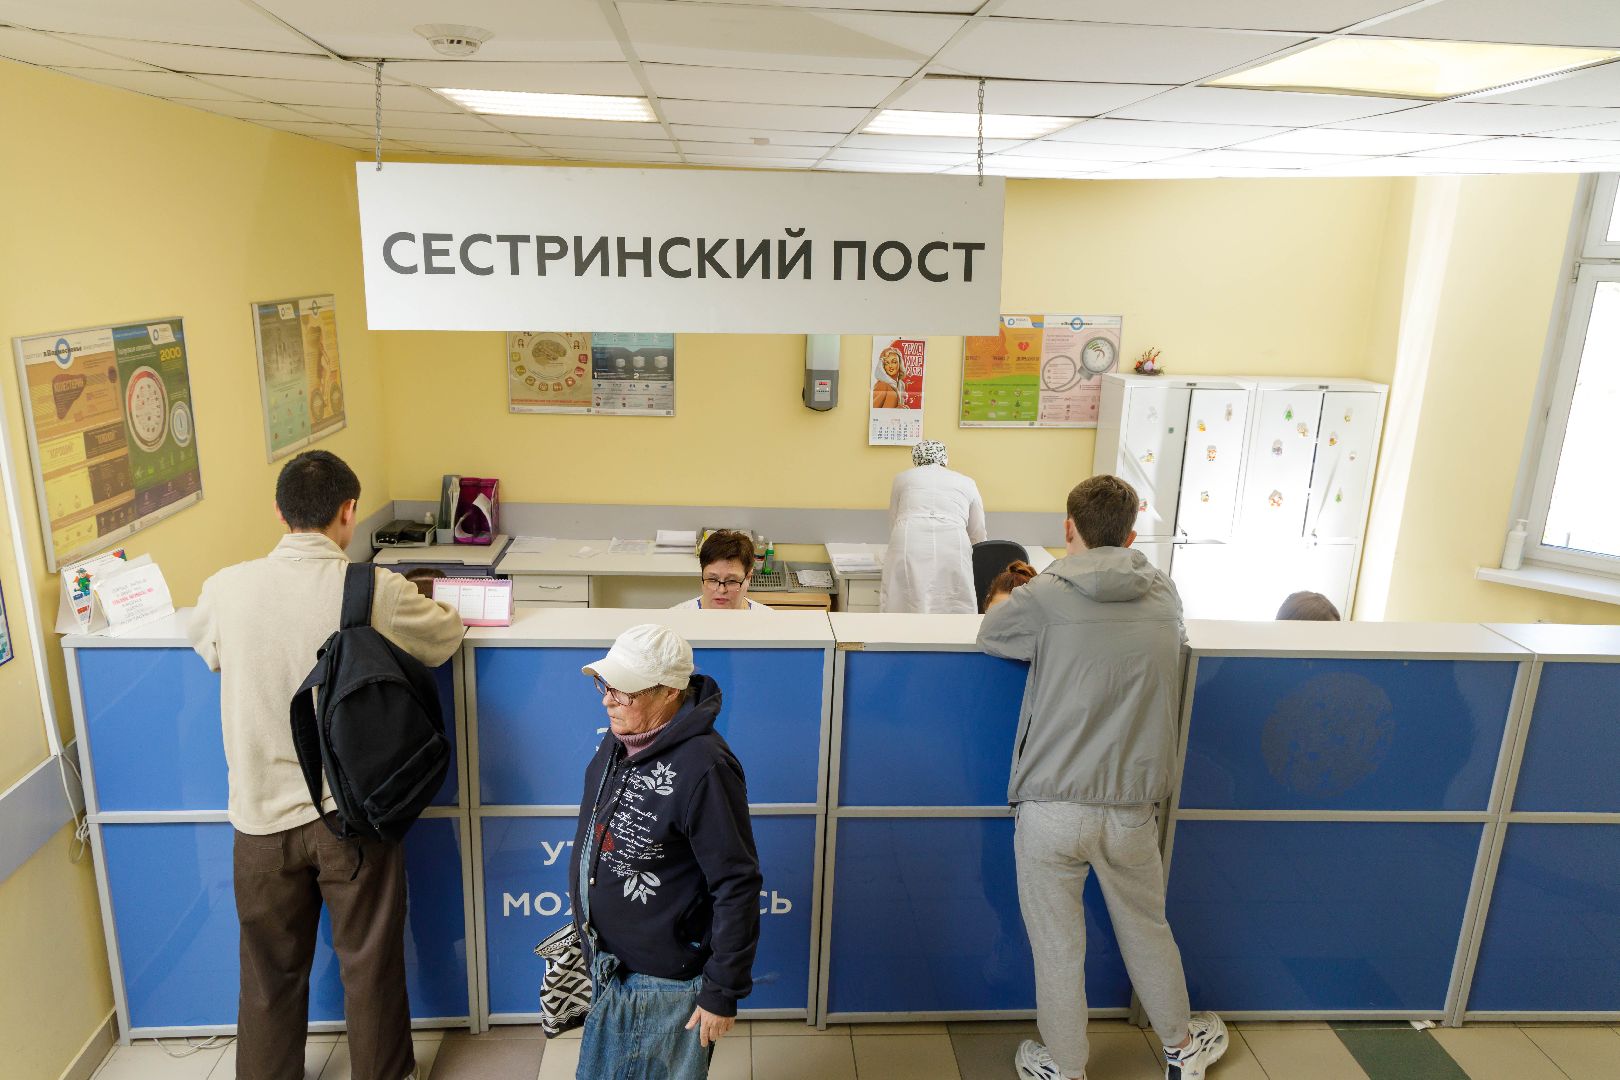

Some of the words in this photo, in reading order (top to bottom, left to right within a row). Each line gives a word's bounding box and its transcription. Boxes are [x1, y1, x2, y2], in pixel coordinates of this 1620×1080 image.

[383, 228, 812, 280] СЕСТРИНСКИЙ
[834, 239, 985, 282] ПОСТ
[159, 347, 182, 361] 2000
[541, 840, 573, 867] У
[503, 891, 574, 918] МО
